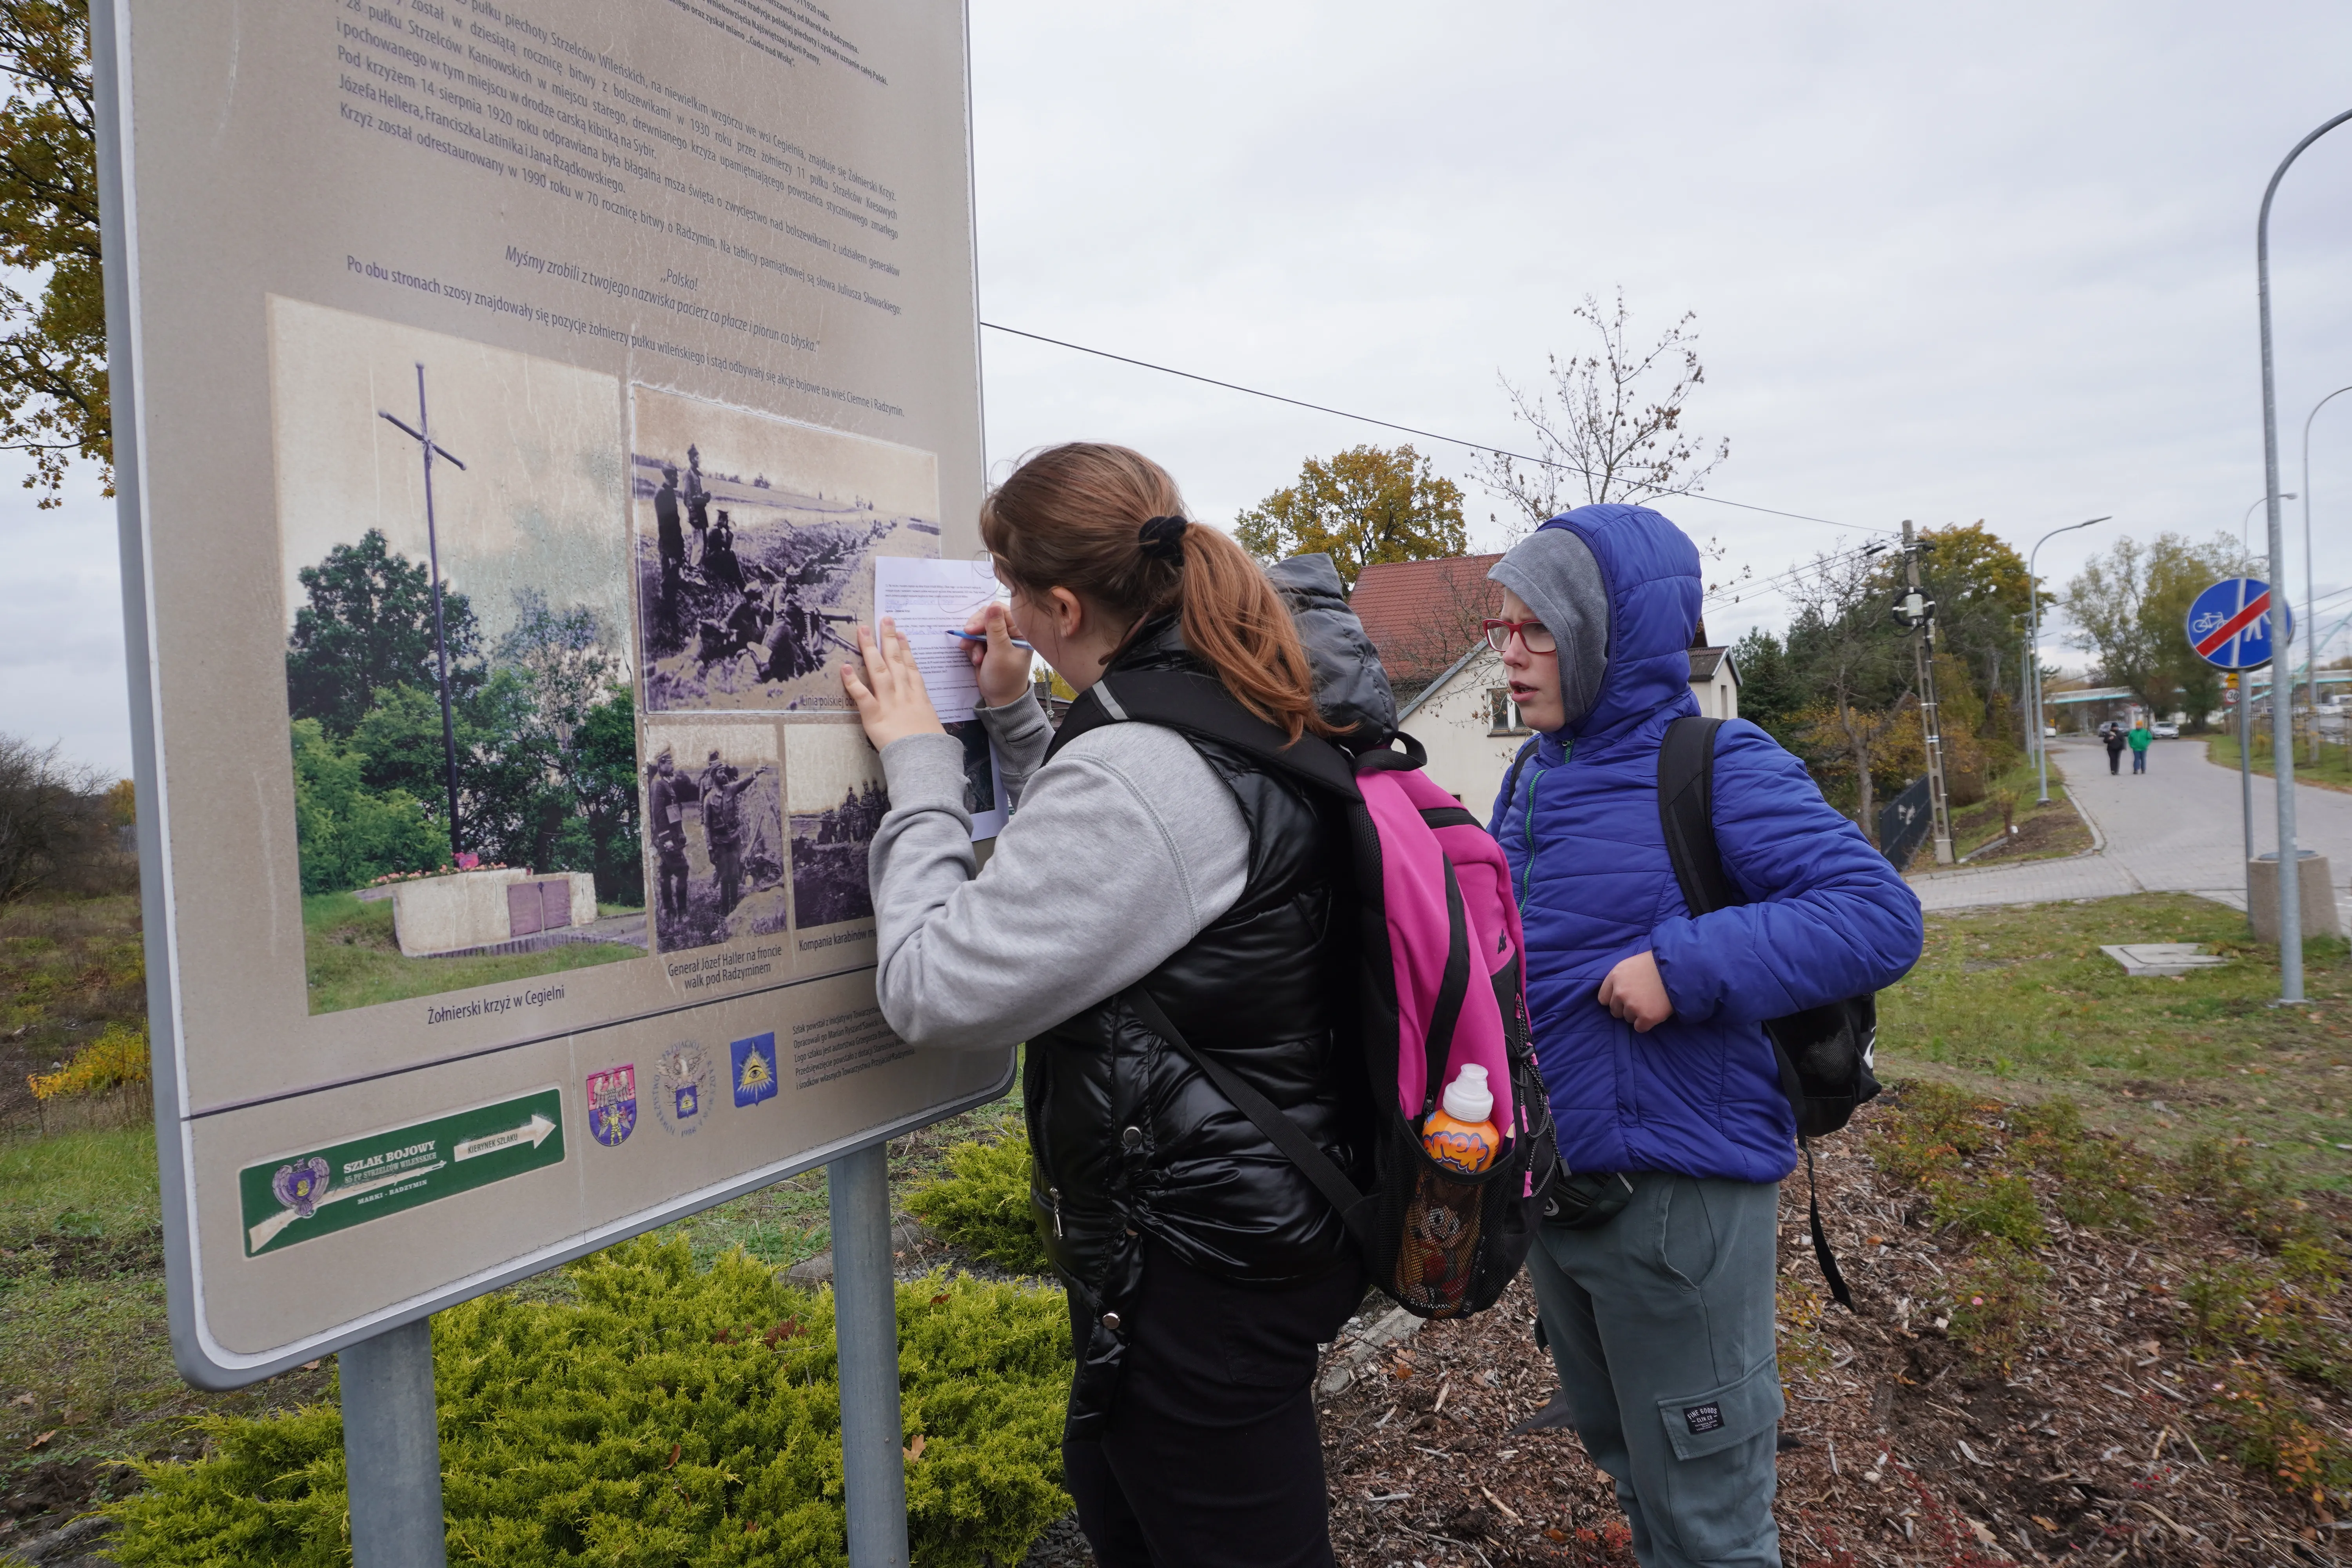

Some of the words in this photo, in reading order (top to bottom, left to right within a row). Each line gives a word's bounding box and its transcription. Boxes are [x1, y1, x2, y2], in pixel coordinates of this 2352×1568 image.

[762, 0, 797, 21] arszawską
[797, 14, 804, 23] od
[805, 16, 822, 33] Marek
[822, 27, 829, 37] do
[829, 30, 859, 54] Radzymina.
[803, 0, 817, 13] 1920
[817, 9, 831, 22] roku.
[691, 6, 705, 20] oraz
[706, 13, 725, 29] zyskał
[726, 24, 745, 40] miano
[765, 45, 776, 57] nad
[747, 1, 771, 20] tradycje
[771, 16, 793, 34] polskiej
[793, 28, 817, 47] piechoty
[817, 39, 820, 48] i
[820, 43, 839, 60] zyskały
[840, 54, 860, 71] uznanie
[860, 65, 873, 79] całej
[872, 70, 888, 86] Polski.
[751, 19, 787, 48] Najświętszej
[788, 39, 802, 54] Marii
[802, 47, 821, 66] Panny,
[472, 0, 501, 22] pułku
[505, 14, 548, 44] piechoty
[551, 32, 596, 63] Strzelców
[598, 53, 648, 89] Wileńskich,
[651, 81, 661, 93] na
[665, 86, 708, 115] niewielkim
[711, 108, 743, 131] wzgórzu
[745, 124, 756, 137] we
[759, 131, 771, 143] wsi
[773, 134, 806, 162] Cegielnia,
[808, 153, 836, 174] znajduje
[837, 166, 846, 181] się
[848, 168, 877, 192] Żołnierski
[879, 184, 897, 201] Krzyż.
[339, 73, 377, 101] Józefa
[379, 88, 424, 121] Hellera,
[425, 105, 481, 140] Franciszka
[483, 127, 524, 155] Latinika
[524, 143, 528, 157] i
[529, 145, 552, 166] Jana
[553, 153, 626, 193] Rządkowskiego.
[340, 101, 373, 128] Krzyż
[377, 119, 412, 141] został
[416, 132, 504, 176] odrestaurowany
[508, 165, 517, 178] w
[521, 167, 546, 188] 1990
[550, 180, 571, 197] roku
[574, 189, 584, 201] w
[587, 191, 599, 207] 70
[602, 199, 638, 224] rocznicę
[641, 209, 664, 233] bitwy
[668, 223, 673, 233] o
[676, 222, 717, 249] Radzymin.
[720, 239, 730, 254] Na
[733, 245, 758, 266] tablicy
[760, 256, 805, 283] pamiątkowej
[807, 273, 815, 287] są
[817, 275, 835, 291] słowa
[837, 282, 862, 301] Juliusza
[863, 291, 902, 316] Słowackiego:
[505, 245, 546, 274] Myśmy
[546, 261, 580, 281] zrobili
[581, 272, 588, 283] z
[589, 272, 630, 298] twojego
[631, 287, 676, 310] nazwiska
[677, 300, 710, 320] pacierz
[710, 311, 720, 323] co
[720, 312, 748, 331] płacze
[748, 320, 752, 332] i
[753, 323, 779, 341] piorun
[780, 333, 789, 344] co
[347, 255, 363, 274] Po
[365, 261, 388, 281] obu
[391, 270, 441, 294] stronach
[443, 285, 472, 306] szosy
[474, 293, 534, 321] znajdowały
[535, 307, 549, 327] się
[551, 314, 586, 334] pozycje
[588, 321, 629, 347] żołnierzy
[631, 335, 655, 351] pułku
[657, 341, 705, 366] wileńskiego
[706, 353, 709, 365] i
[711, 356, 727, 372] stąd
[729, 360, 764, 382] odbywały
[766, 370, 776, 386] się
[777, 372, 795, 390] akcje
[796, 377, 820, 395] bojowe
[822, 387, 830, 397] na
[831, 388, 846, 401] wieś
[847, 391, 870, 408] Ciemne
[871, 398, 873, 408] i
[874, 398, 905, 417] Radzymin.
[802, 695, 818, 706] Linia
[819, 694, 844, 709] polskiej
[799, 935, 832, 951] Kompania
[833, 929, 866, 945] karabinów
[668, 958, 699, 977] Generał
[701, 954, 720, 971] Józef
[722, 951, 744, 966] Haller
[746, 951, 755, 962] na
[757, 945, 781, 959] froncie
[684, 974, 704, 989] walk
[706, 970, 720, 988] pod
[722, 964, 770, 981] Radzyminem
[428, 1001, 481, 1024] Żołnierski
[484, 995, 511, 1014] krzyż
[513, 996, 522, 1007] w
[525, 985, 564, 1007] Cegielni
[343, 1154, 384, 1174] SZLAK
[386, 1140, 436, 1163] BOJOWY
[468, 1140, 495, 1154] KIERYNEK
[497, 1133, 518, 1146] SZLAKU
[345, 1175, 352, 1184] 85
[354, 1172, 362, 1181] PP
[363, 1161, 399, 1179] STRZELCÓW
[399, 1151, 437, 1168] WILEŃSKICH
[358, 1192, 383, 1205] MARKI
[389, 1179, 427, 1196] RADZYMIN
[1687, 1410, 1700, 1420] FINE
